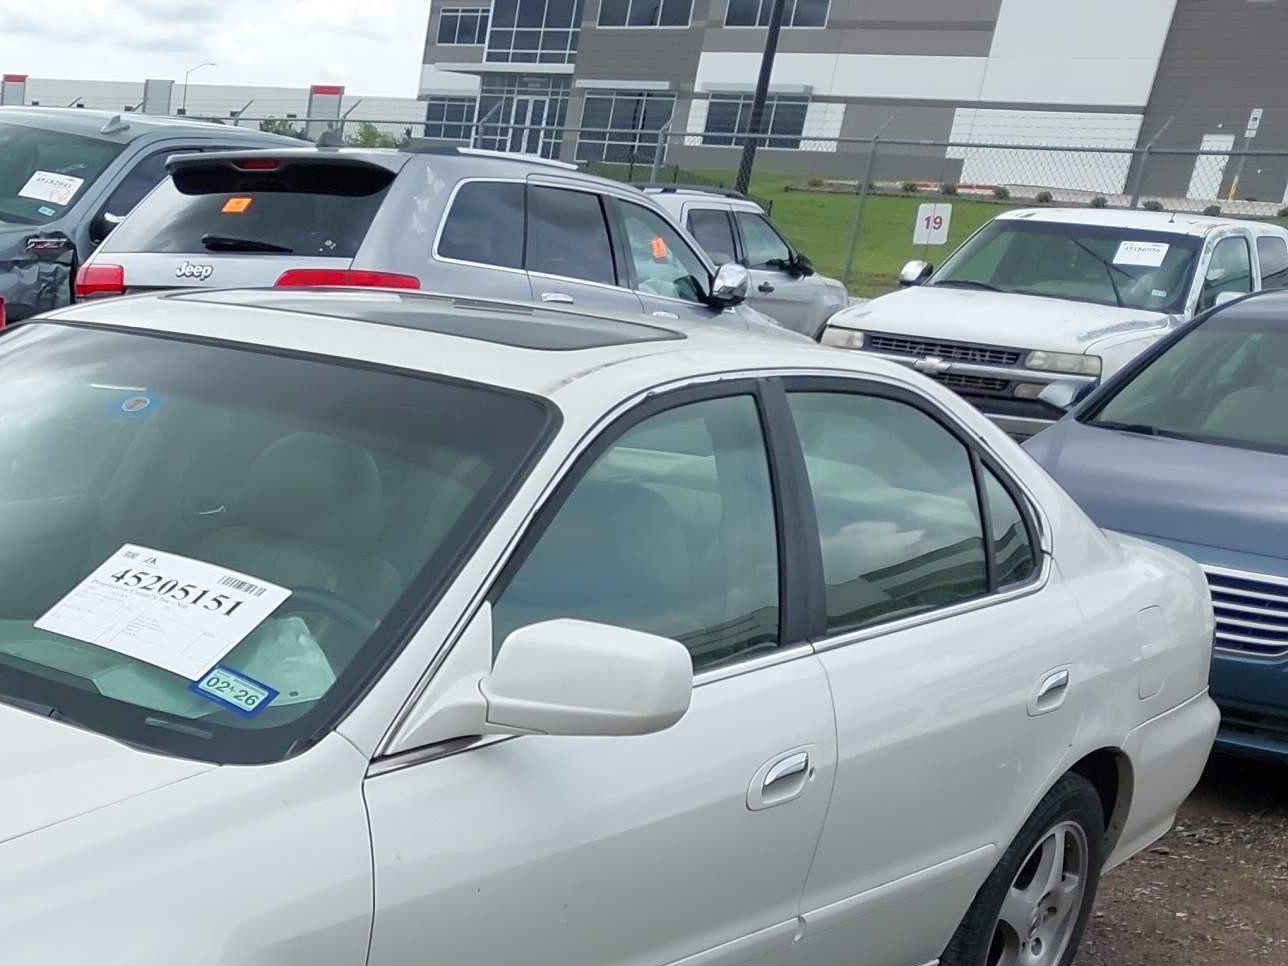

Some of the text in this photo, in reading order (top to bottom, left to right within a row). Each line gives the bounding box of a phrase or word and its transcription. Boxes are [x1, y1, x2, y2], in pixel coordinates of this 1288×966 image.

[924, 215, 943, 230] 19
[175, 262, 213, 281] Jeep
[111, 568, 244, 617] 45205151
